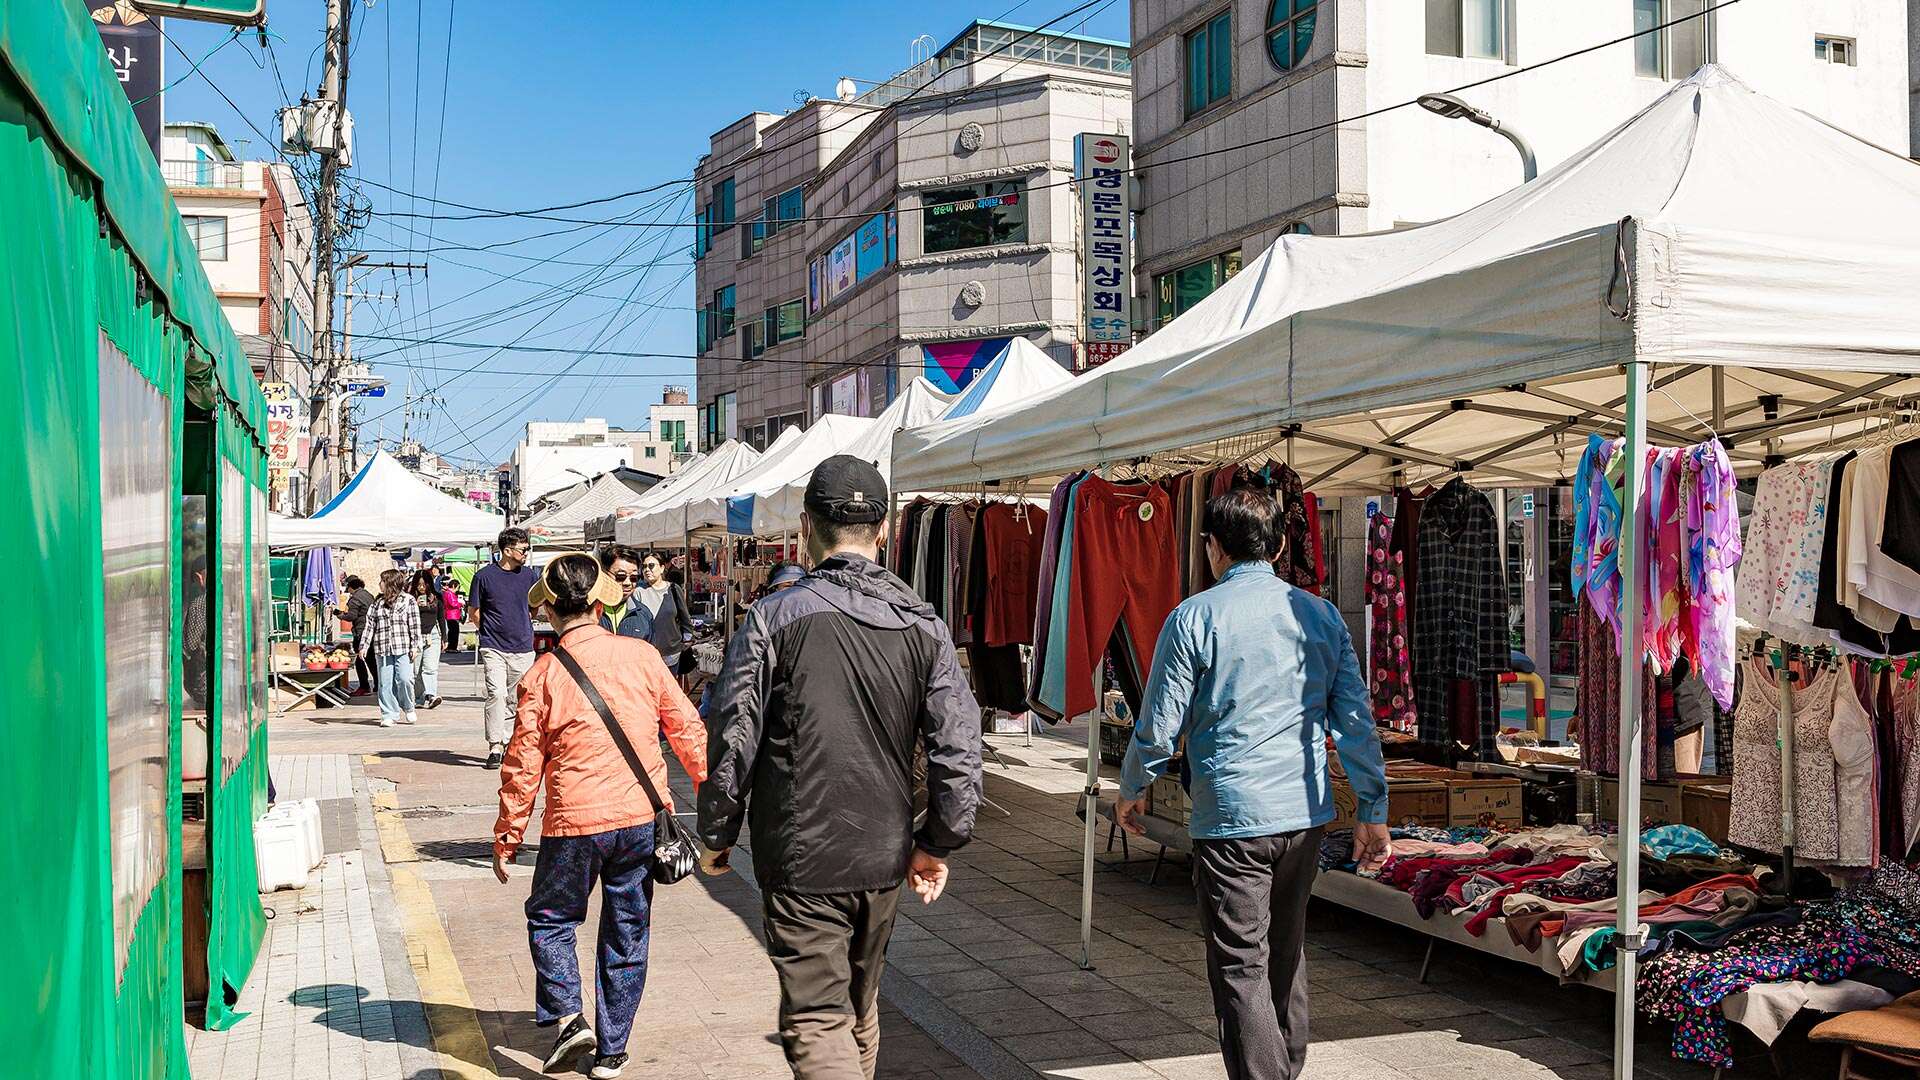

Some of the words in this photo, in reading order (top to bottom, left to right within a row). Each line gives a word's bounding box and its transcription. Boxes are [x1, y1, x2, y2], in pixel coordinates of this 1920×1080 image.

[954, 200, 975, 212] 7080
[1092, 167, 1123, 313] 명문포목상회
[267, 405, 294, 420] 시장
